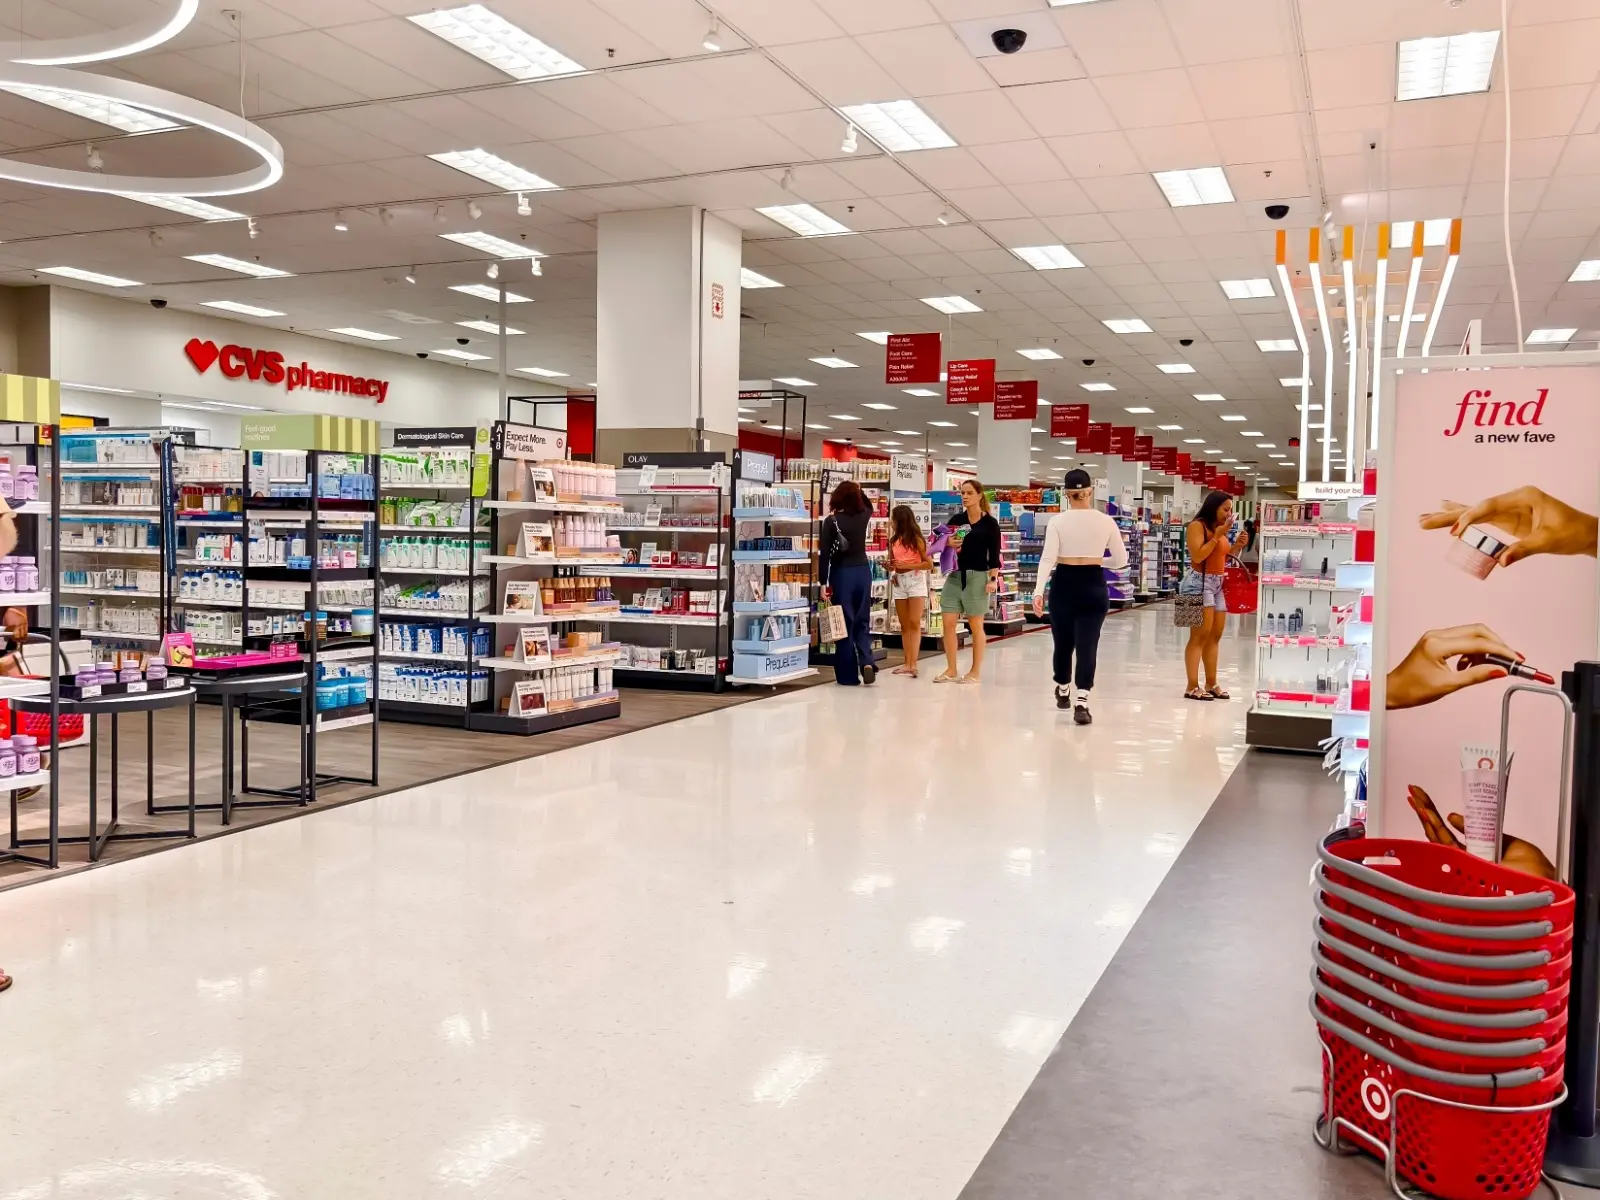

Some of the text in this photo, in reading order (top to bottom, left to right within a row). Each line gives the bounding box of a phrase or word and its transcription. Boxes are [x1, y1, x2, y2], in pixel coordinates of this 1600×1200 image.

[219, 344, 390, 404] CVS pharmacy
[1444, 388, 1549, 436] find
[244, 424, 276, 433] Feel-good
[506, 431, 547, 444] Expect More.
[1475, 431, 1555, 443] a new fave
[506, 442, 534, 452] Pay Less.
[628, 455, 648, 463] OLAY
[898, 461, 909, 470] Expect
